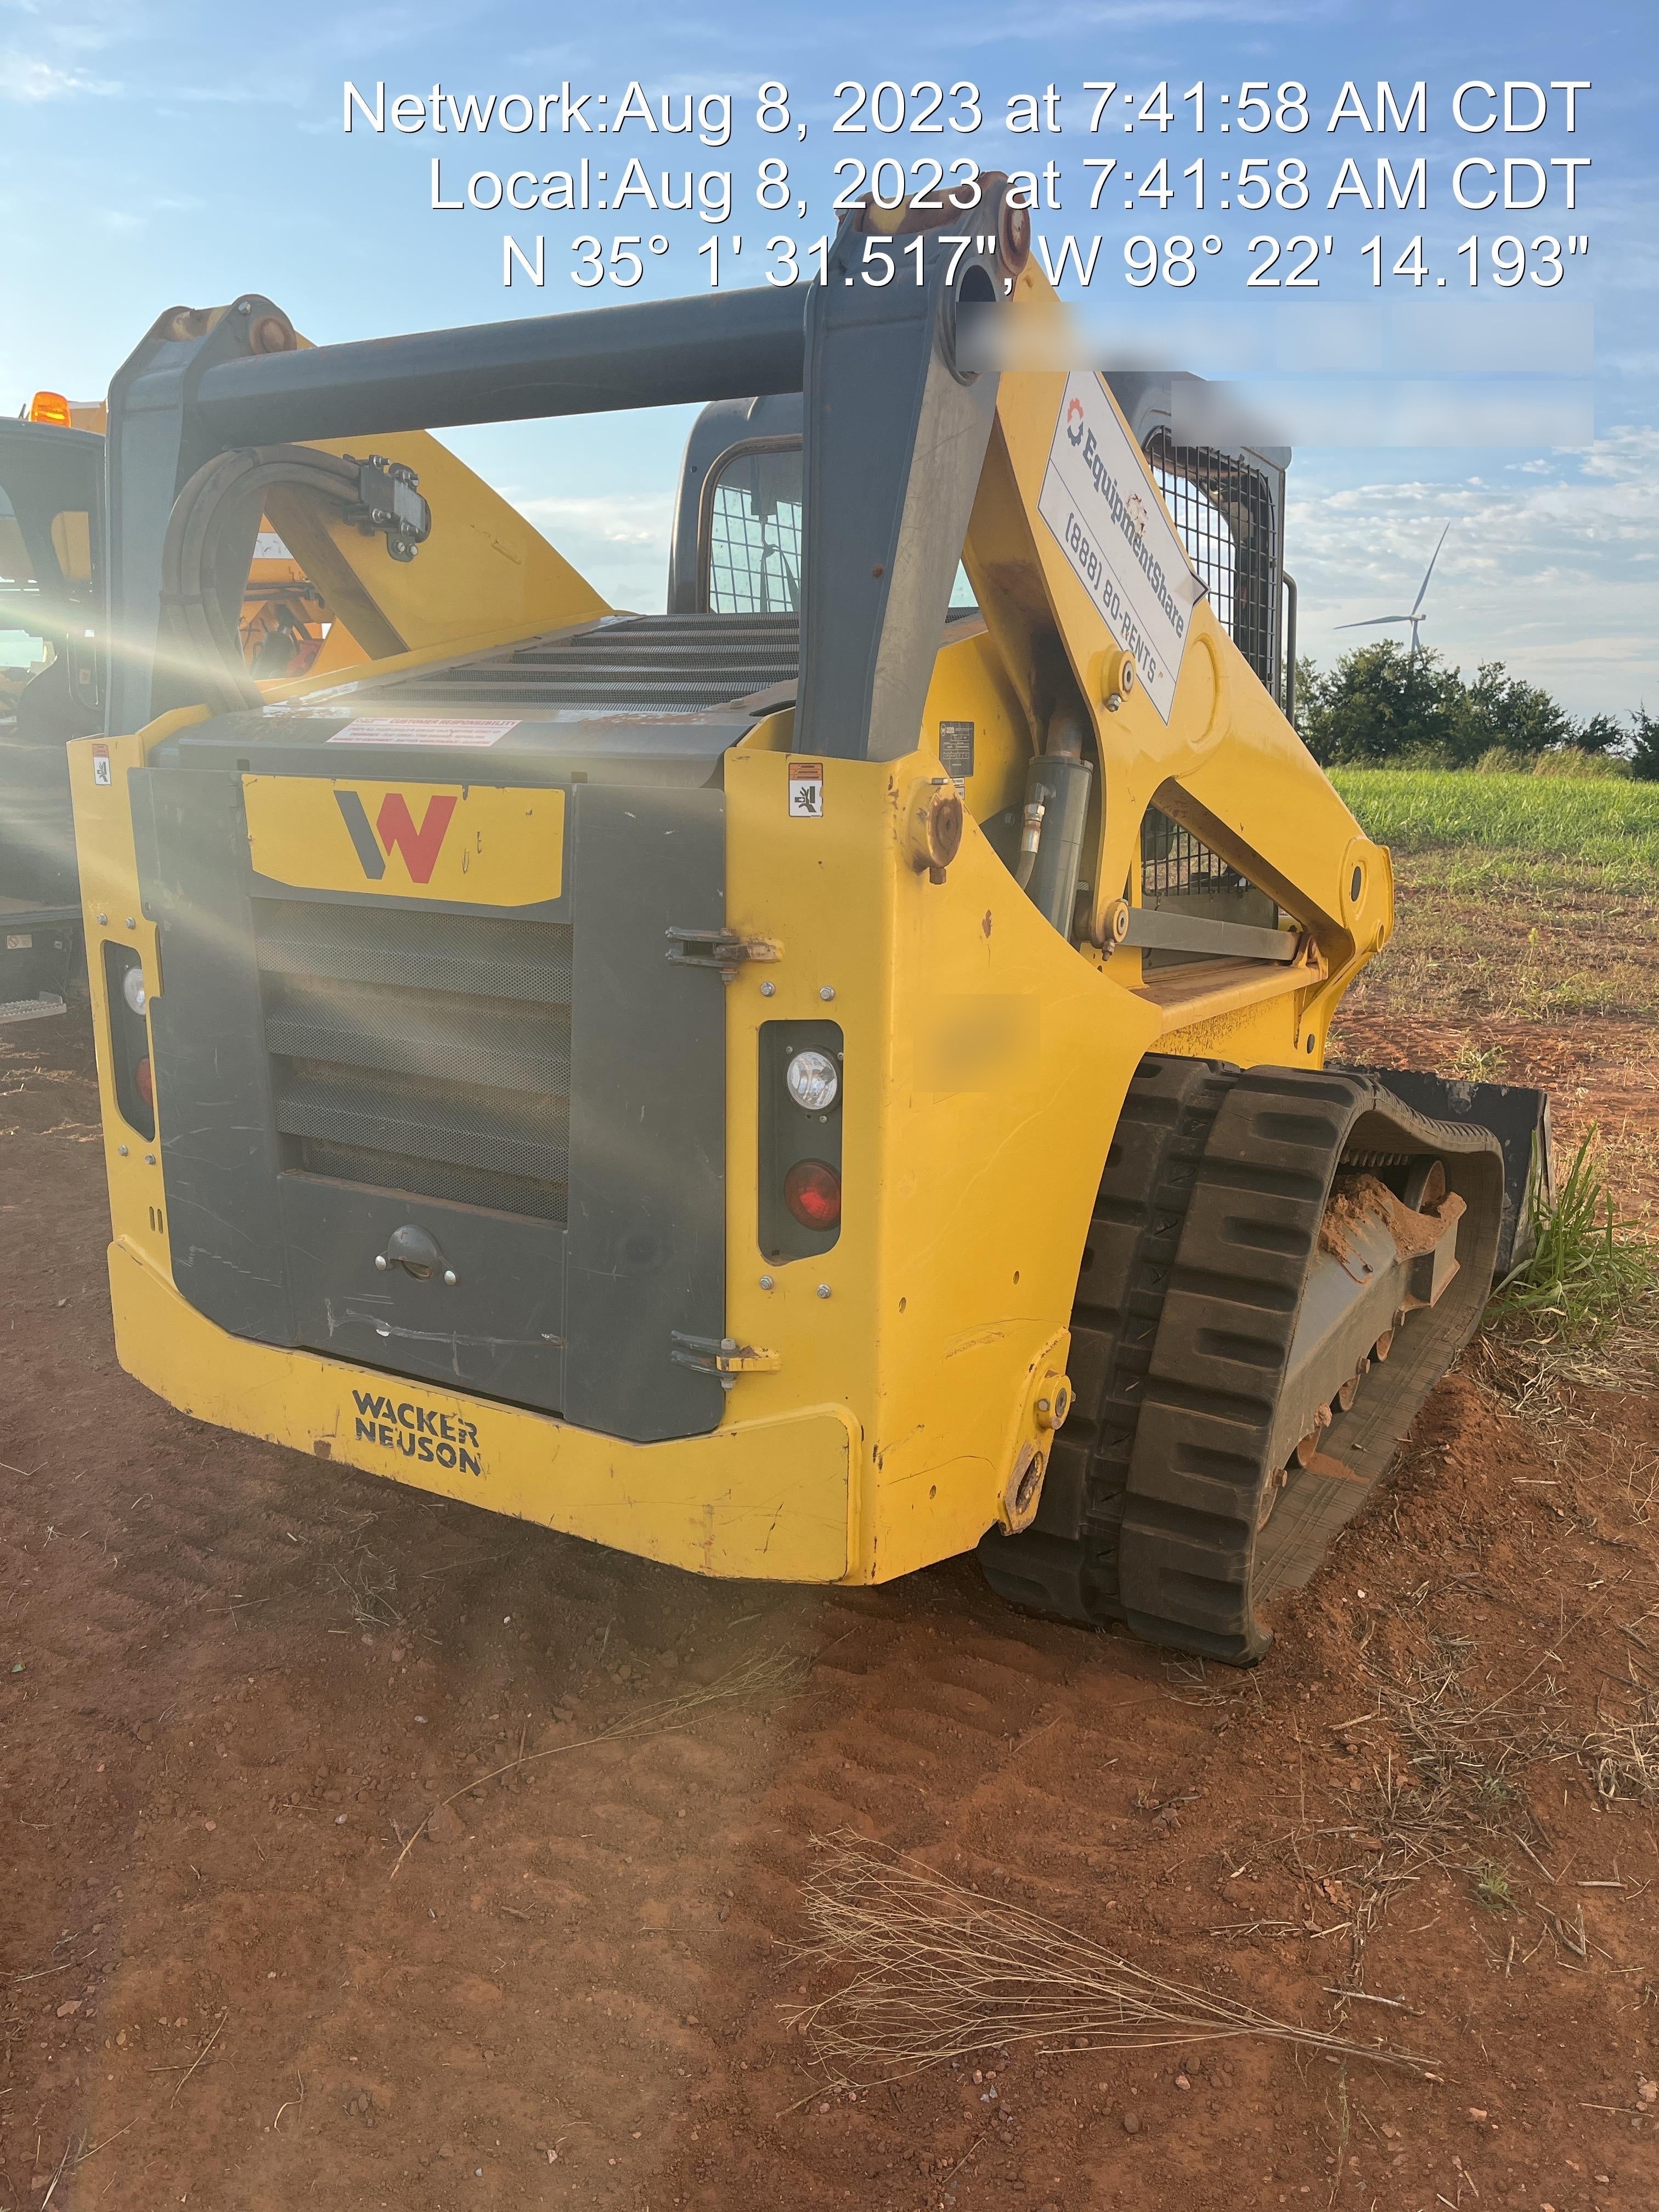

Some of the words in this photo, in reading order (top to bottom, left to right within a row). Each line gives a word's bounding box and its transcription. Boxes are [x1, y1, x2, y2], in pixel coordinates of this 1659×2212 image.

[1081, 428, 1184, 640] EquipmentShare
[1065, 512, 1103, 591] (888)
[1103, 583, 1156, 684] 80-RENTS
[352, 1390, 479, 1448] WACKER
[356, 1417, 482, 1477] NEUSON
